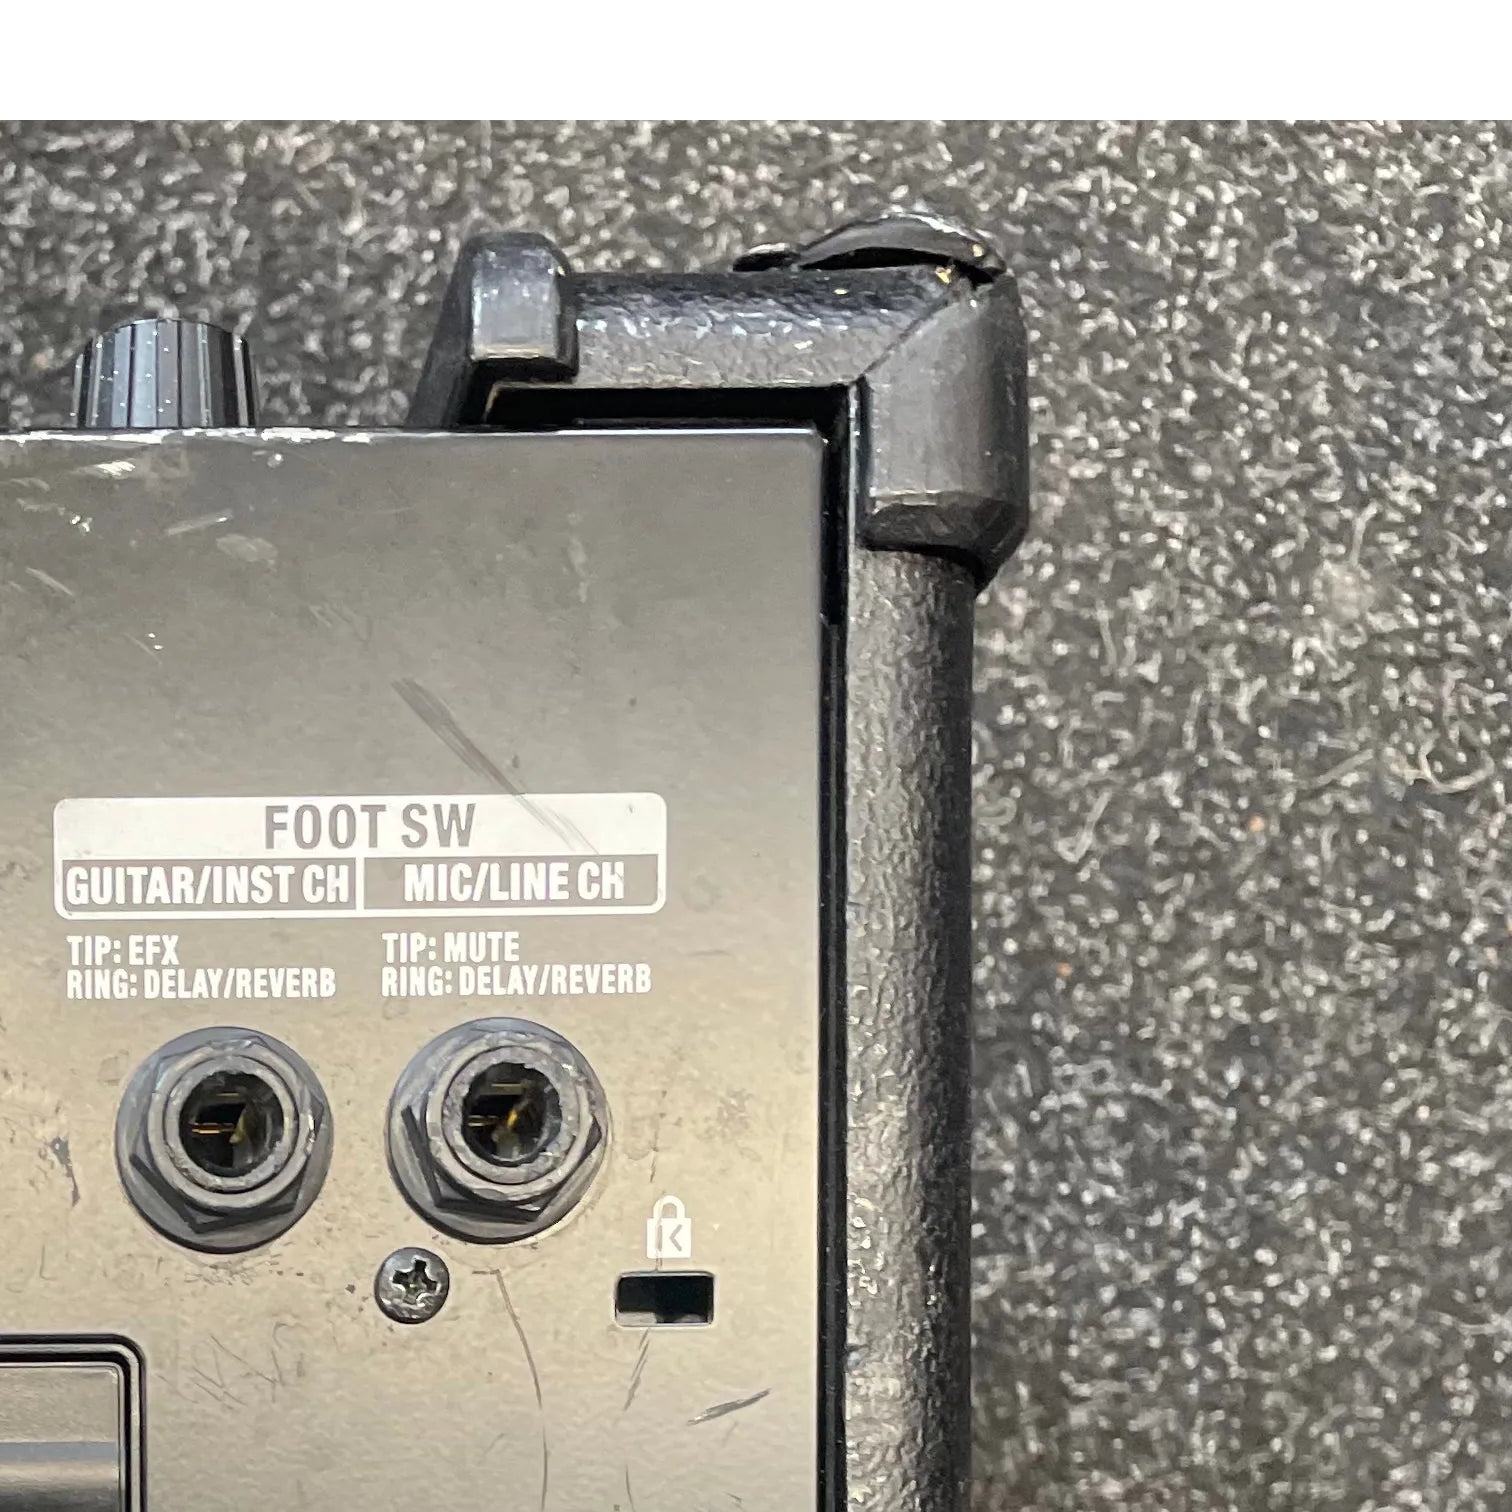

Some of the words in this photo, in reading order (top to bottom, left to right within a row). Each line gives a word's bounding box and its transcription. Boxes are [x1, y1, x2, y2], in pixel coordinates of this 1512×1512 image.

[265, 803, 386, 850] FOOT
[400, 802, 476, 849] SW
[65, 865, 295, 905] GUITAR/INST
[302, 864, 349, 903] CH
[404, 862, 570, 901] MIC/LINE
[577, 861, 624, 900] CH
[67, 935, 122, 966] TIP:
[128, 934, 180, 966] EFX
[382, 932, 437, 963] TIP:
[444, 931, 520, 962] MUTE
[66, 968, 138, 1000] RING:
[143, 967, 336, 999] DELAY/REVERB
[381, 965, 453, 997] RING:
[459, 963, 651, 996] DELAY/REVERB
